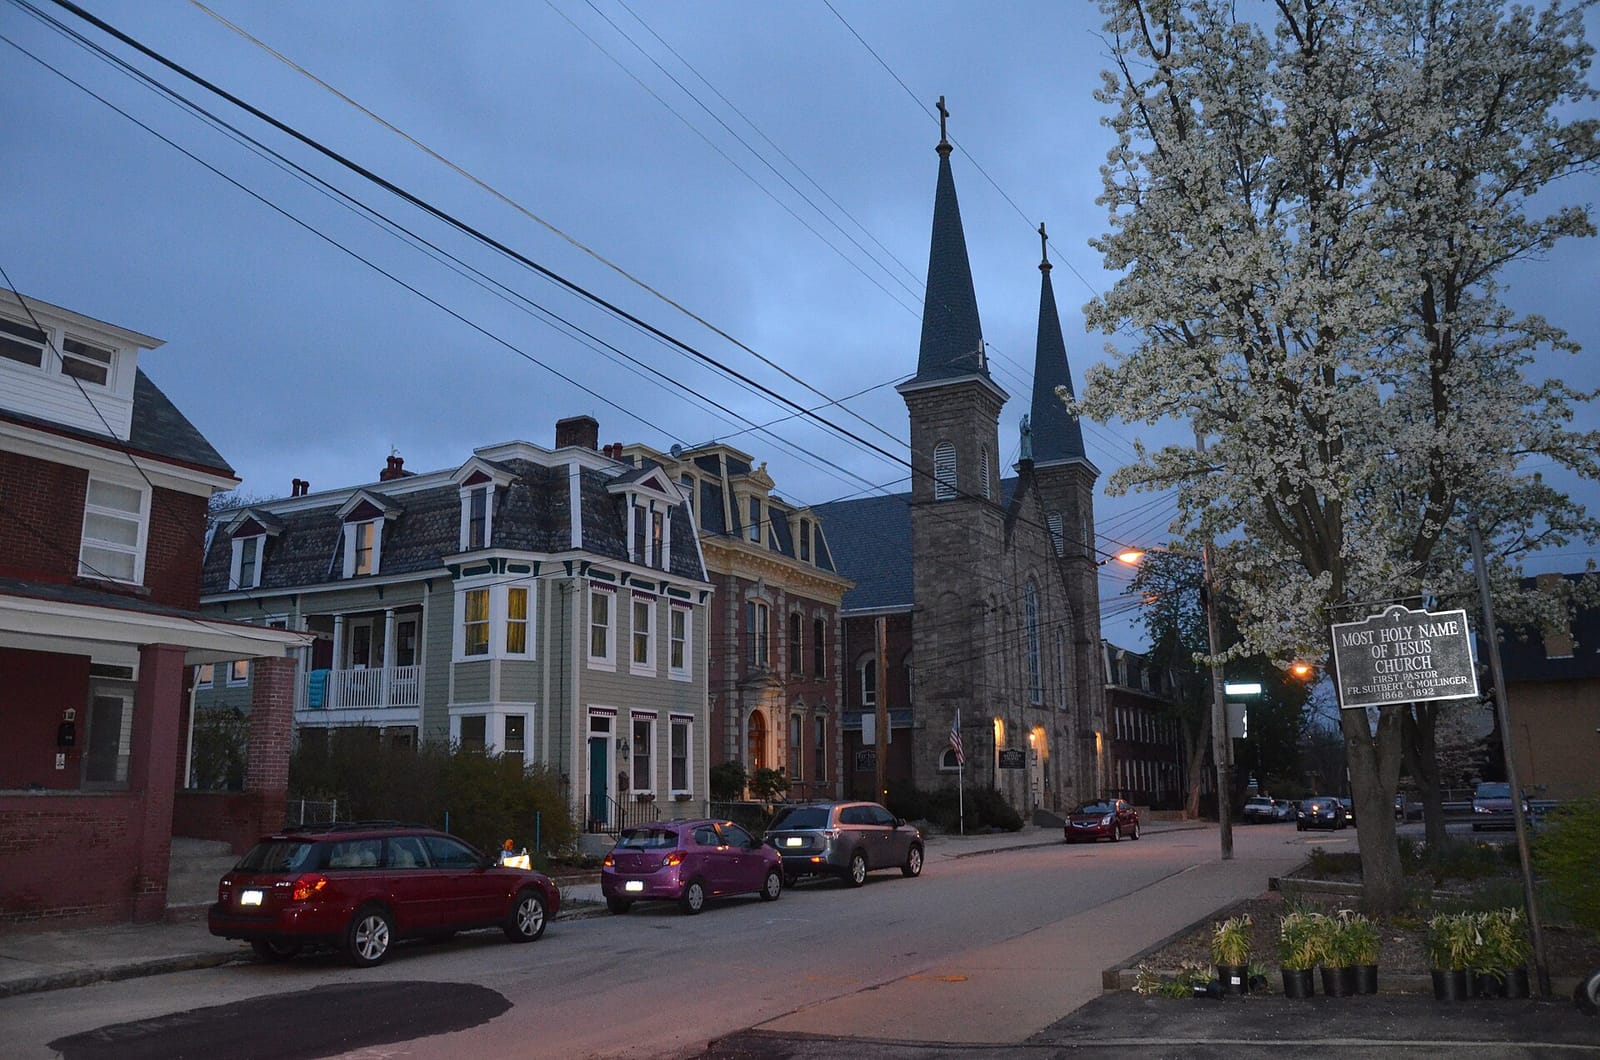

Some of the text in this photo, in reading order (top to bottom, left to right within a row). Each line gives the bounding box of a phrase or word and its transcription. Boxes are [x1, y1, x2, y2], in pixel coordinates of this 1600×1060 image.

[1342, 621, 1459, 647] MOST HOLY NAME
[1372, 640, 1432, 659] OF JESUS
[1375, 656, 1432, 674] CHURCH
[1362, 682, 1404, 694] SUITBERT
[1416, 676, 1468, 688] MOLLINGER
[1373, 670, 1438, 684] FIRST PASTOR
[1382, 691, 1404, 700] 1868
[1412, 688, 1435, 696] 1892
